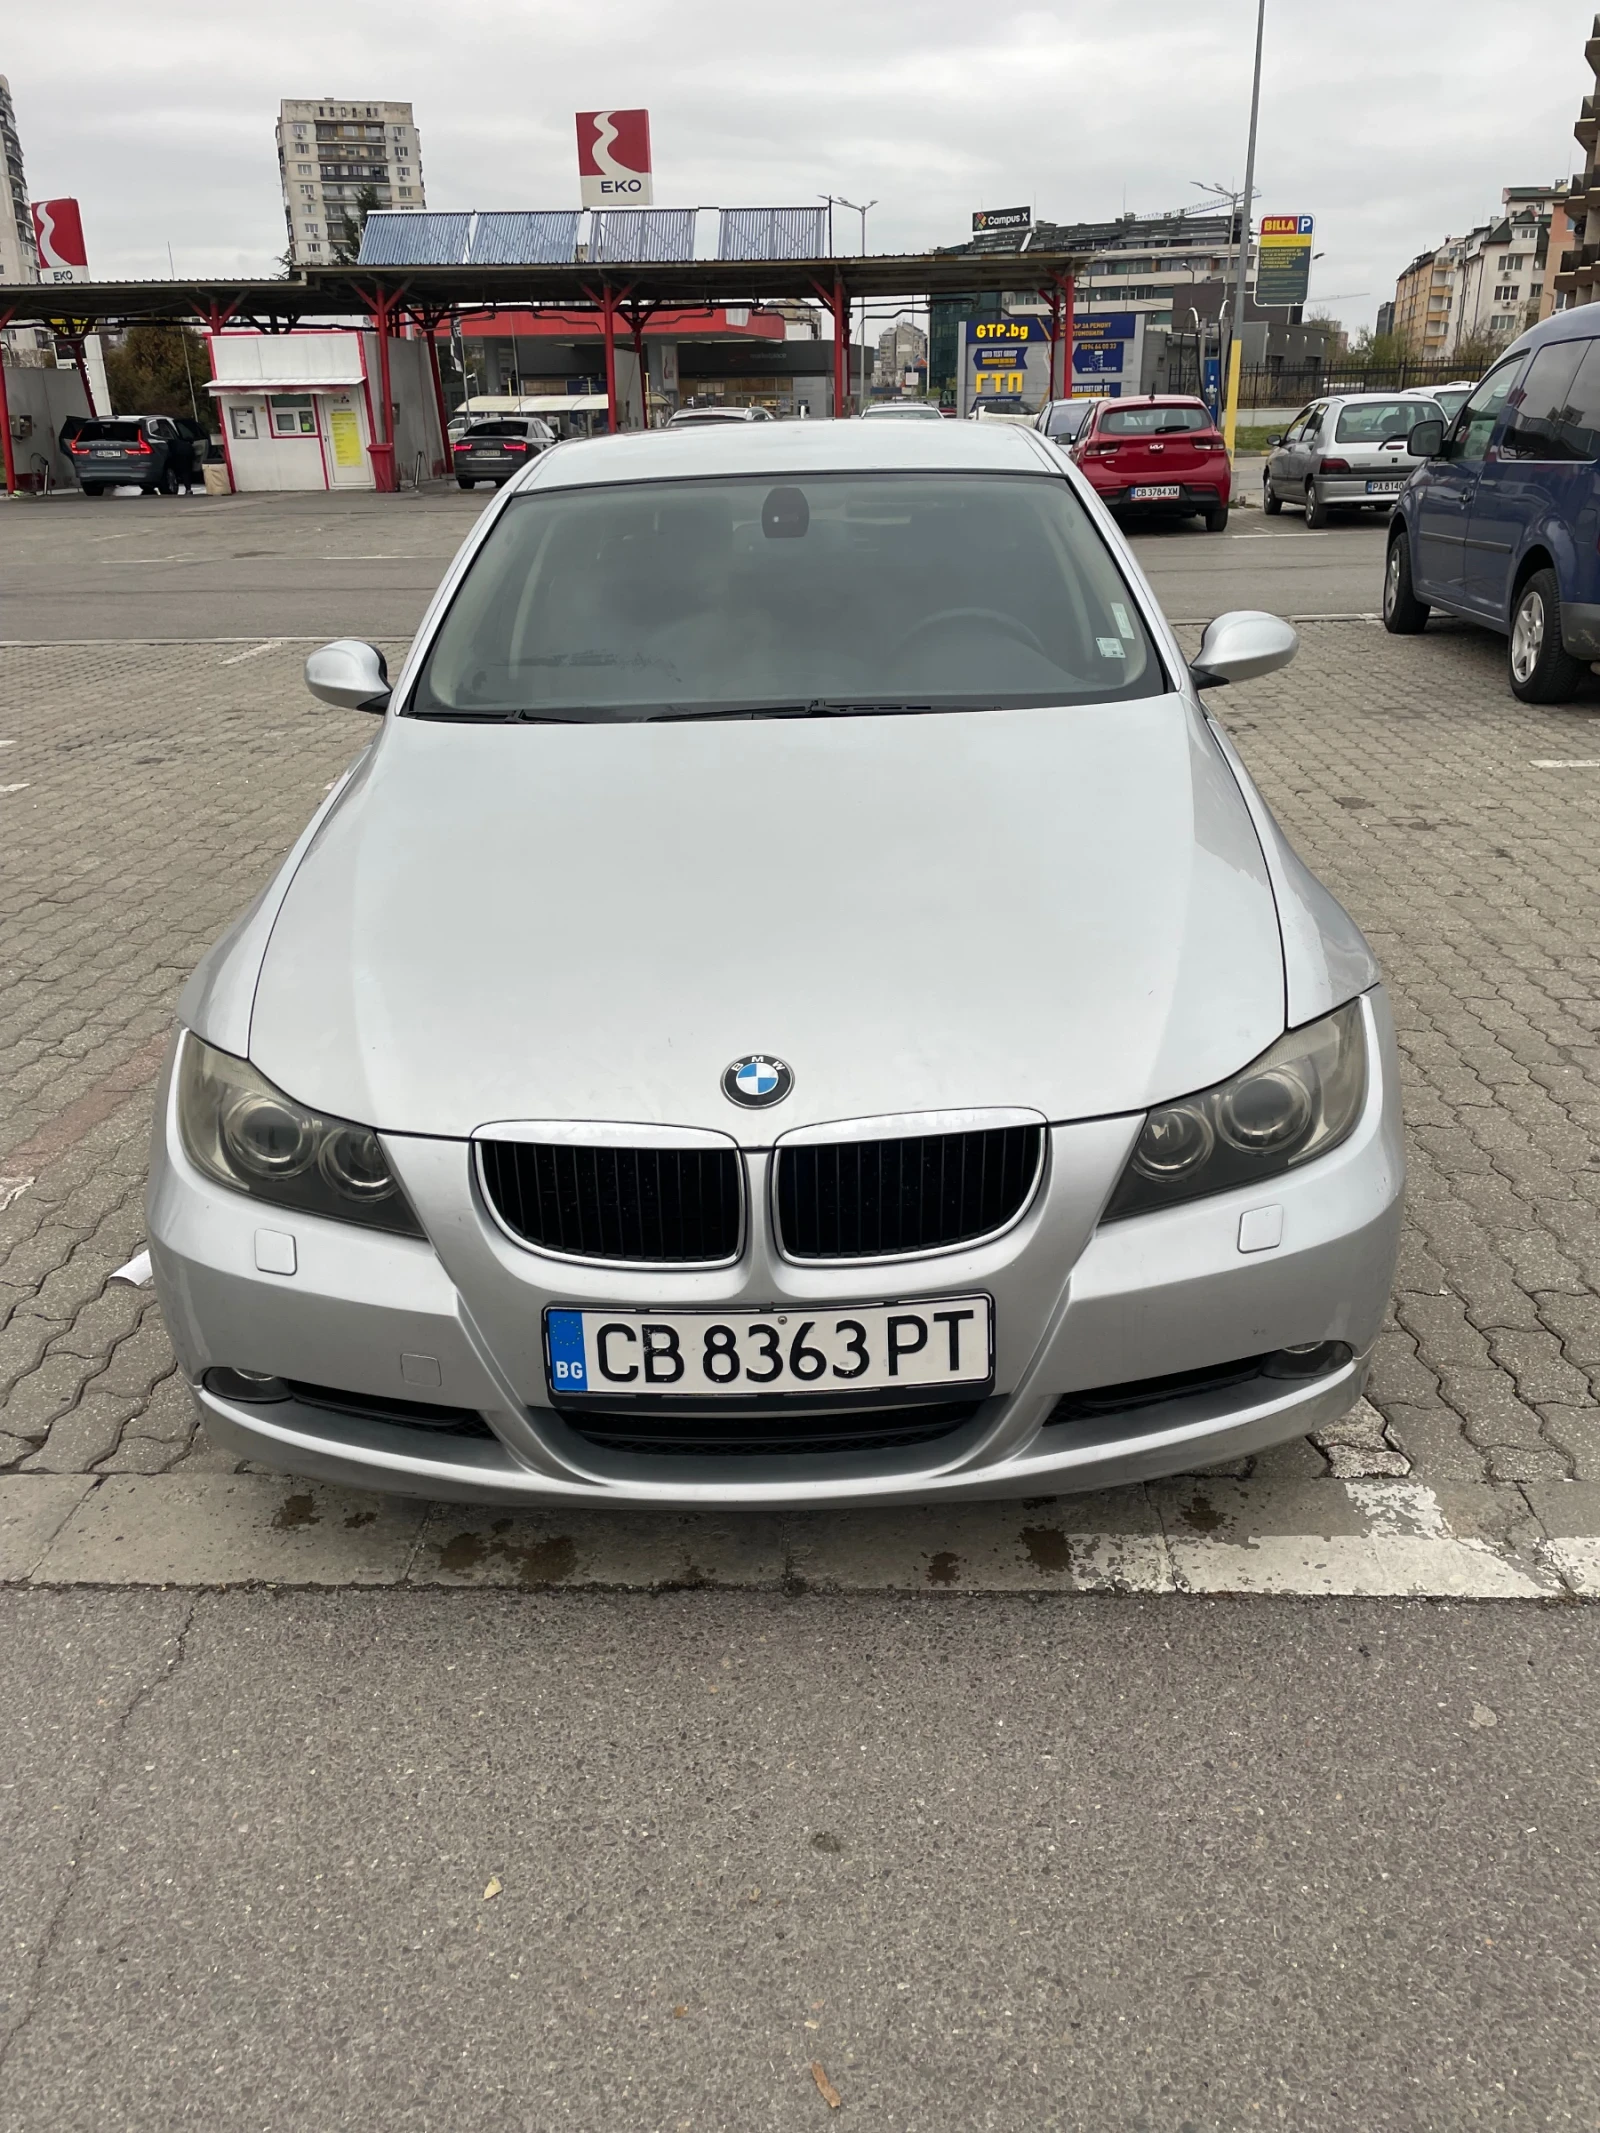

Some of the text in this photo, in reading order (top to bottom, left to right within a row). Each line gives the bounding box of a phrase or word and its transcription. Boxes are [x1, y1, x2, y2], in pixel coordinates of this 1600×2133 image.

[600, 179, 642, 193] EKO
[988, 212, 1028, 226] Campus X
[1263, 217, 1311, 232] BILLA P
[53, 270, 73, 281] EKO
[976, 323, 1029, 340] GTP.bg
[976, 372, 1024, 393] ГТП
[1136, 487, 1178, 497] CB 3784 XM
[1372, 482, 1384, 491] PA
[731, 1056, 786, 1072] BMW
[556, 1309, 975, 1383] BG CB 8363 PT
